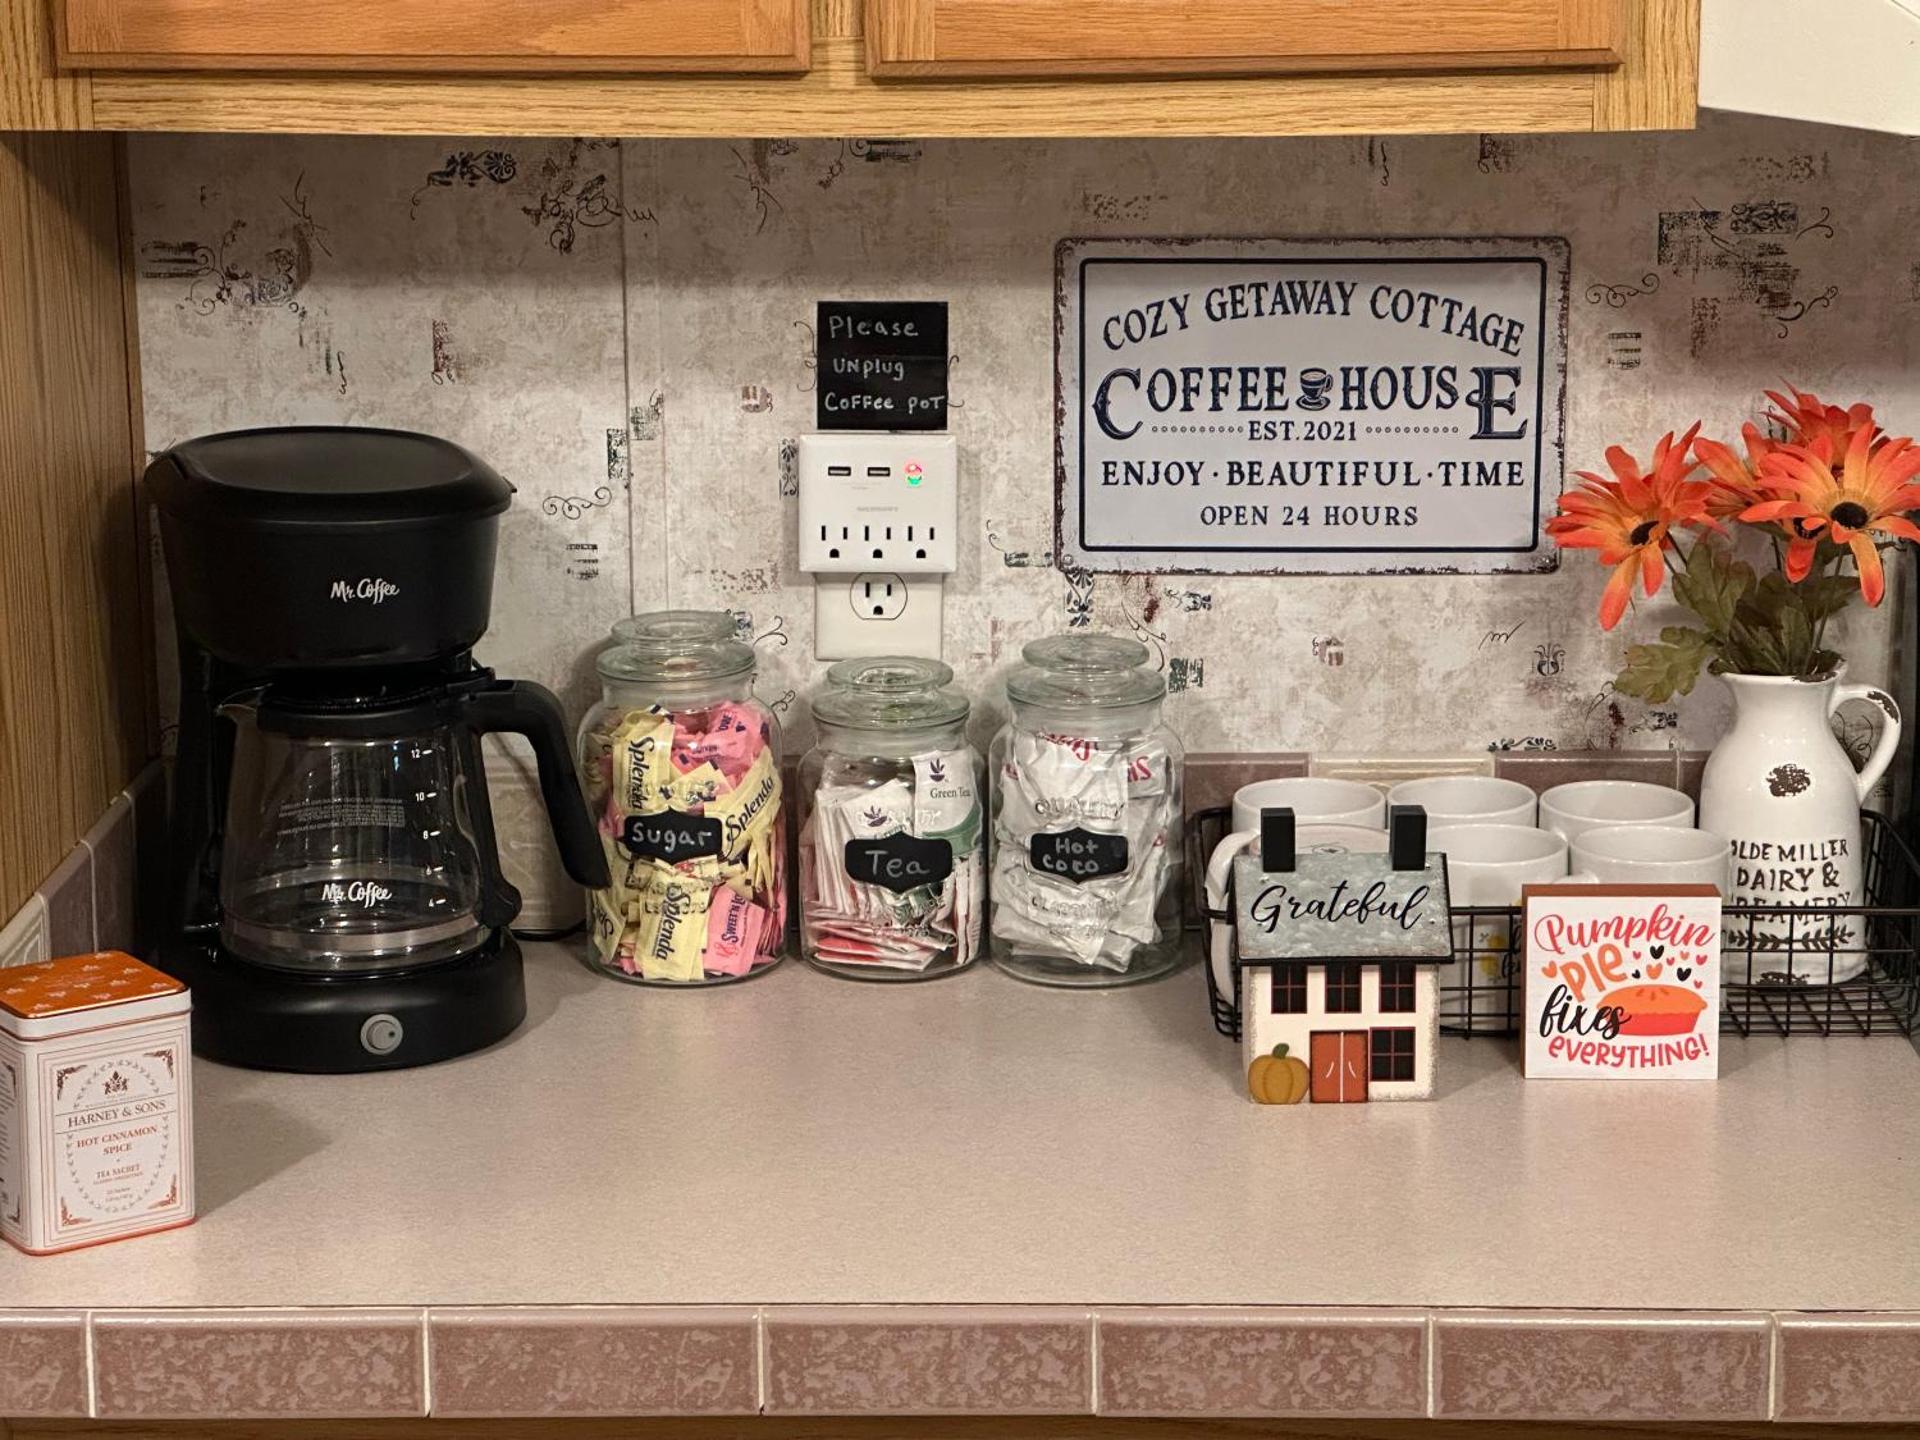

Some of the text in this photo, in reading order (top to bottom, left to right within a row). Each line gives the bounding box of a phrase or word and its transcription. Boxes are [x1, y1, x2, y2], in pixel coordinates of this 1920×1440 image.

[829, 315, 919, 339] Please
[1103, 280, 1525, 356] COZY GETAWAY COTTAGE
[1092, 365, 1528, 440] COFFEE HOUSE
[1101, 460, 1525, 487] ENJOY BEAUTIFUL TIME
[1200, 505, 1418, 526] OPEN 24 HOURS
[330, 578, 400, 605] Mr. Coffee
[411, 749, 421, 759] 12
[628, 736, 655, 811] Splenda
[415, 791, 425, 802] 10
[930, 786, 972, 799] Green Tea
[723, 776, 774, 850] Splenda
[631, 823, 713, 854] Sugar
[1055, 837, 1099, 854] Hot
[1777, 839, 1849, 862] MILLER
[864, 849, 931, 878] Tea
[1737, 861, 1840, 892] DAIRY &
[322, 881, 393, 908] Mr. Coffee
[1250, 880, 1430, 934] Grateful
[655, 882, 692, 961] Splenda
[1534, 903, 1716, 955] Pumpkin
[1539, 984, 1632, 1041] fixes
[68, 1107, 119, 1128] HARNEY
[121, 1106, 132, 1117] &
[134, 1100, 167, 1115] SONS
[77, 1125, 158, 1149] HOT CINNAMON
[102, 1143, 133, 1156] SPICE
